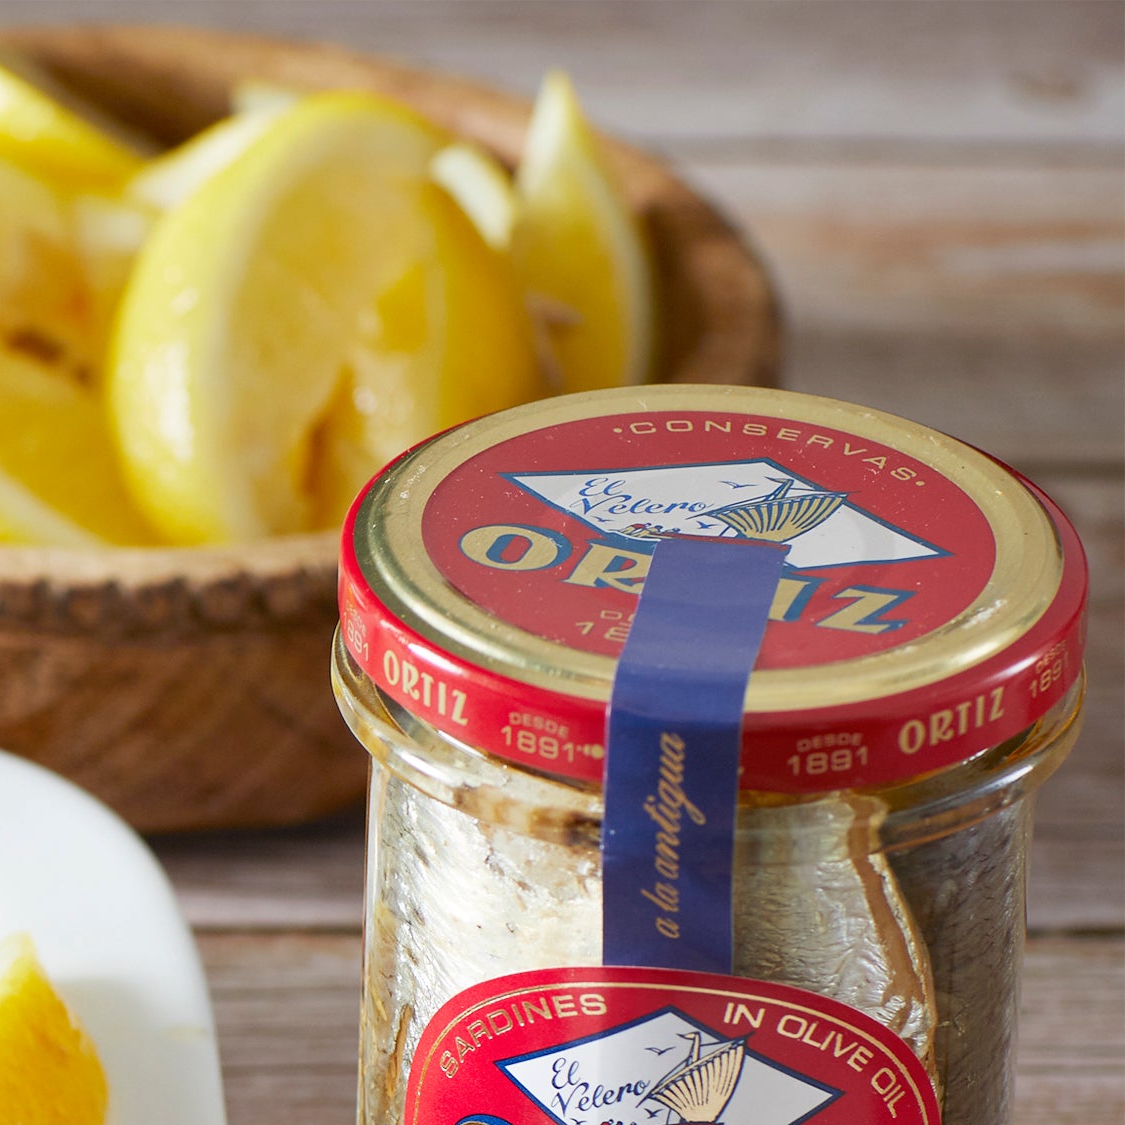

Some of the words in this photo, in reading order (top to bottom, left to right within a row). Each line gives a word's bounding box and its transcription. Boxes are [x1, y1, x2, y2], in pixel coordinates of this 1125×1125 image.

[630, 420, 916, 481] CONSERVAS
[569, 495, 713, 514] Velero
[578, 478, 625, 497] El
[459, 523, 915, 634] ORIZ
[383, 650, 468, 726] ORTIZ
[509, 712, 570, 738] DESDE
[898, 686, 1004, 754] ORTIZ
[501, 725, 574, 763] 1891
[796, 732, 863, 752] DESDE
[787, 746, 868, 776] 1891
[643, 732, 706, 879] antigua
[640, 881, 680, 912] la
[656, 916, 680, 939] a
[439, 993, 608, 1078] SARDINES
[551, 1057, 582, 1089] El
[723, 1002, 766, 1028] IN
[777, 1014, 874, 1072] OLIVE
[871, 1067, 906, 1119] OIL
[550, 1080, 651, 1117] Velero
